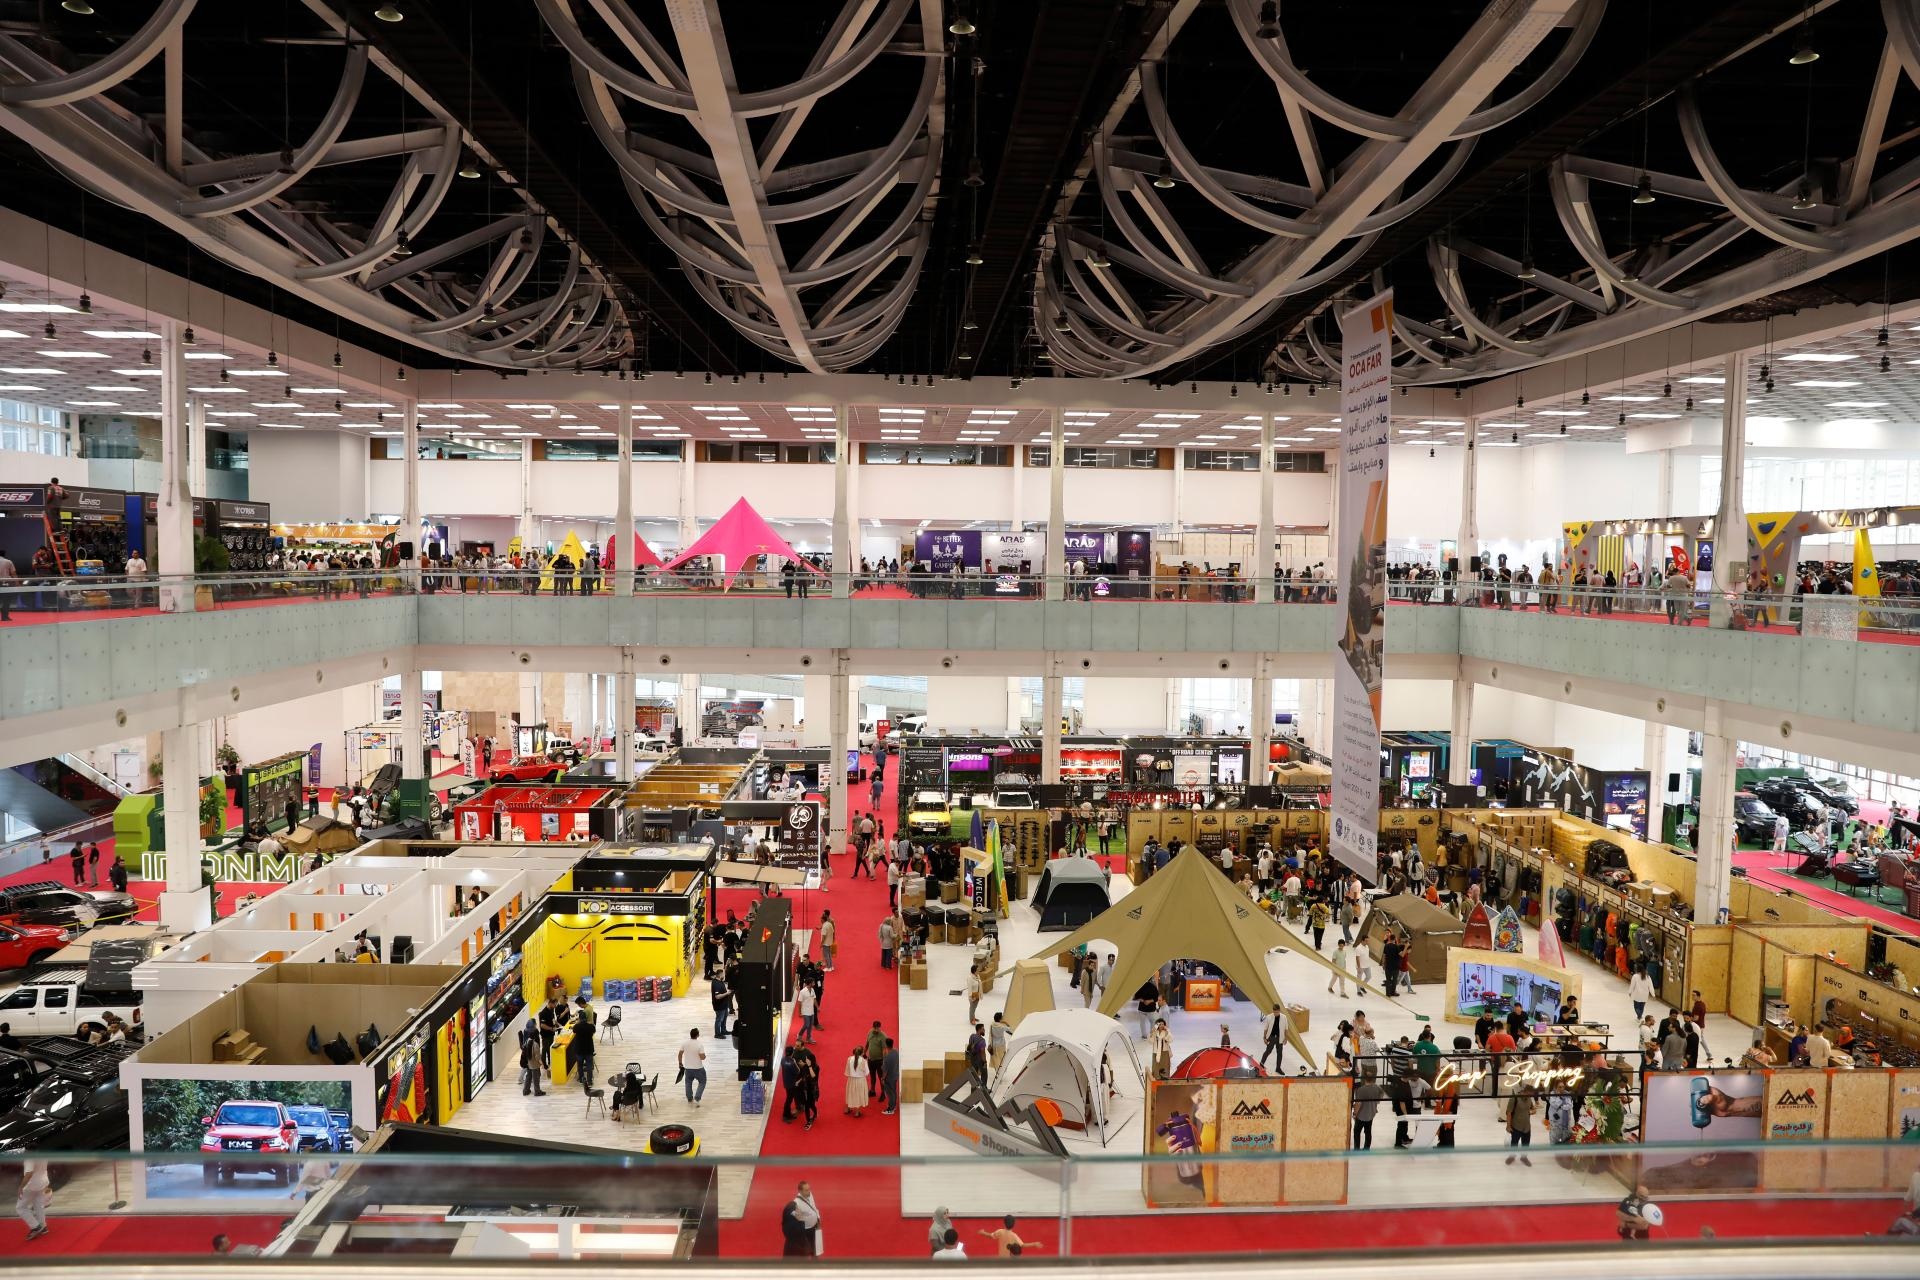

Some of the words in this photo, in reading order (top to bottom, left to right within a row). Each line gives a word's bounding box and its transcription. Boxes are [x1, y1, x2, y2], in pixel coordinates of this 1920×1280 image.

[580, 900, 609, 913] MOP
[1434, 1062, 1487, 1091] Camp
[1504, 1061, 1585, 1088] Shopping
[950, 1119, 981, 1145] Camp
[228, 1141, 253, 1149] KMC
